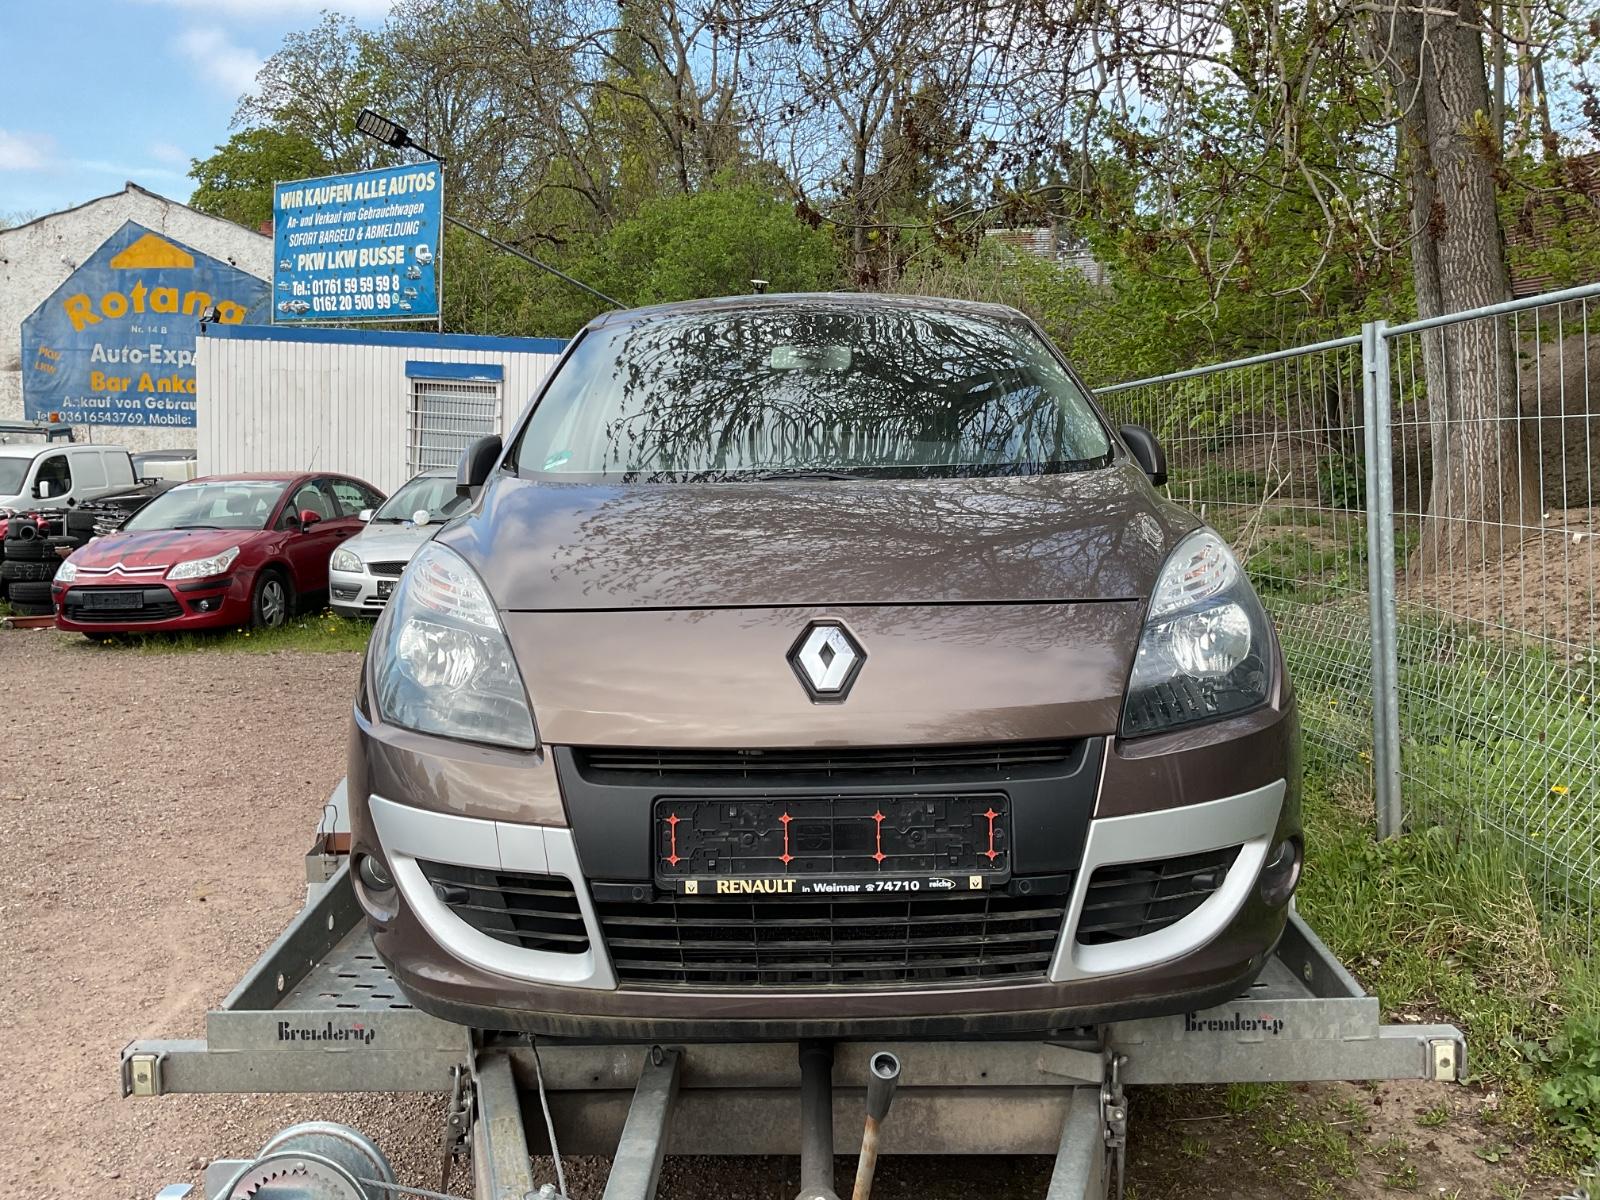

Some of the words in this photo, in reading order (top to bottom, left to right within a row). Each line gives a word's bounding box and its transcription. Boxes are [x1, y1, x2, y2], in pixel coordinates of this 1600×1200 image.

[280, 192, 303, 209] WIR
[305, 184, 352, 206] KAUFEN
[355, 178, 387, 200] ALLE
[388, 171, 435, 195] AUTOS
[287, 216, 299, 229] An-
[300, 212, 313, 227] und
[314, 210, 342, 226] Verkauf
[342, 210, 356, 221] von
[357, 203, 425, 220] Gebrauchtwagen
[289, 232, 317, 248] SOFORT
[318, 228, 355, 245] BARGELD
[356, 228, 364, 241] &
[364, 220, 420, 241] ABMELDUNG
[297, 252, 325, 272] PKW
[327, 250, 357, 269] LKW
[359, 245, 405, 267] BUSSE
[292, 280, 311, 295] Tel.:
[312, 279, 342, 295] 01761
[344, 278, 358, 294] 59
[359, 277, 374, 293] 59
[375, 275, 390, 292] 59
[391, 274, 400, 291] 8
[313, 296, 338, 312] 0162
[339, 295, 351, 310] 20
[354, 294, 374, 310] 500
[376, 293, 391, 309] 99
[131, 325, 144, 333] Nr.
[148, 326, 158, 334] 14
[160, 326, 168, 334] B
[90, 371, 131, 392] Bar
[115, 399, 141, 409] von
[58, 411, 147, 425] 03616543769,
[149, 415, 192, 425] Mobile:
[716, 879, 796, 894] RENAULT
[813, 883, 861, 893] Weimar
[876, 881, 920, 892] 74710
[278, 1021, 375, 1045] Brenderup
[1184, 1011, 1284, 1035] Brenderup
